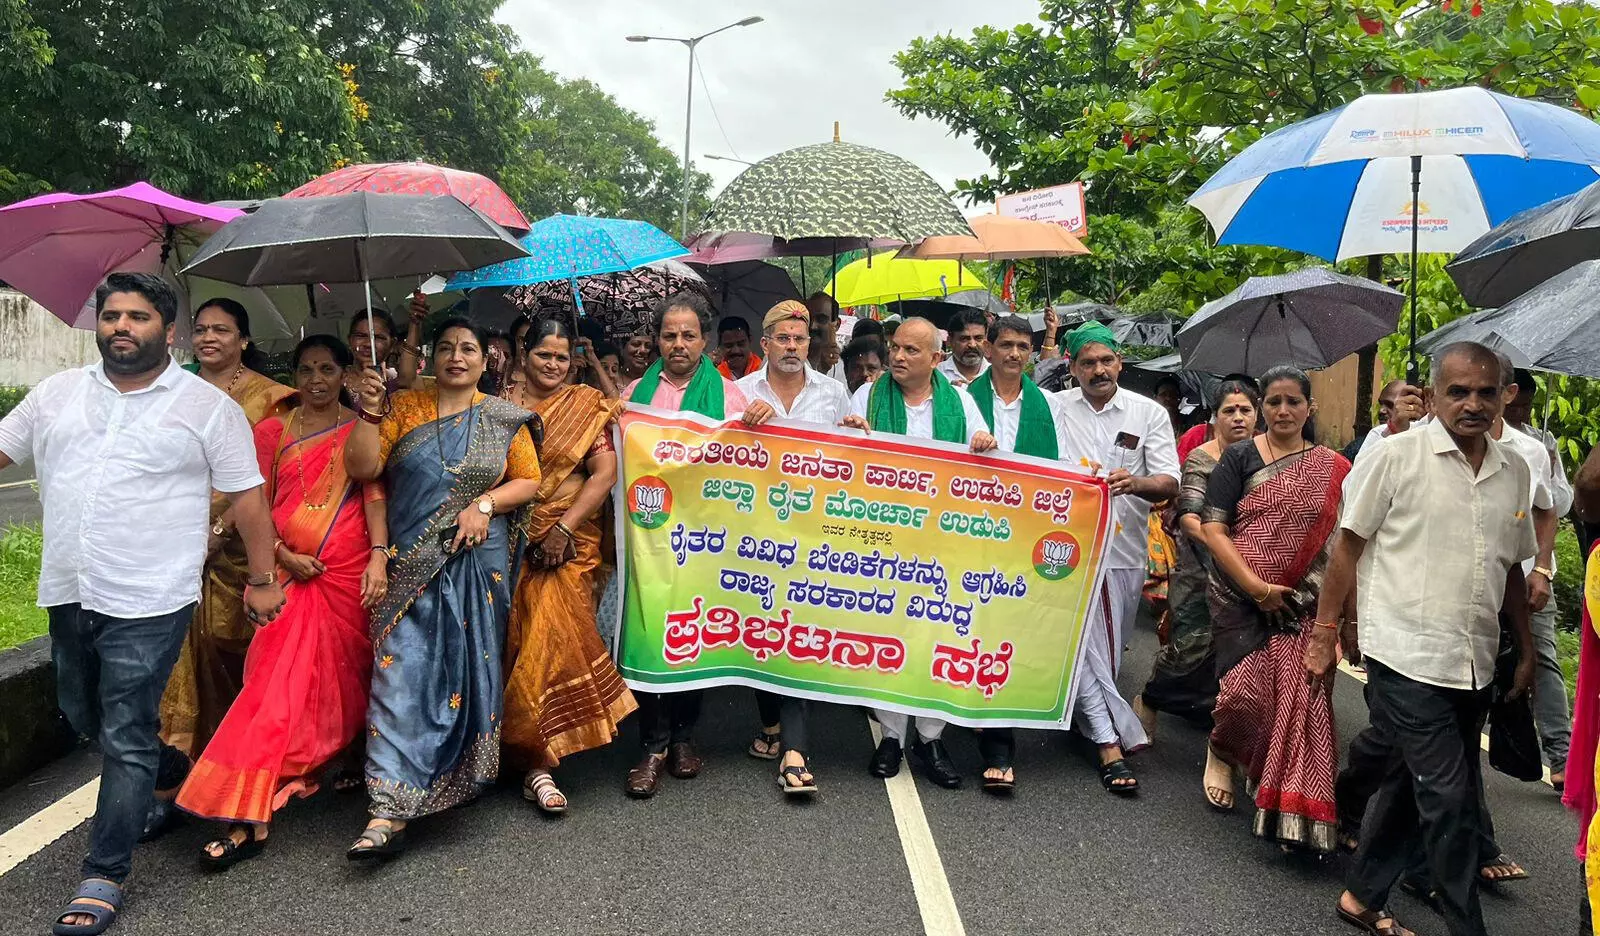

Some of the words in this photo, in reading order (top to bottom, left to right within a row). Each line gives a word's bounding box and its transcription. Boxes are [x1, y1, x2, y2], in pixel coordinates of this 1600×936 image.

[654, 440, 769, 470] ಭಾರತೀಯ
[781, 451, 853, 481] ಜನತಾ
[865, 463, 937, 496] ಪಾರ್ಟಿ,
[950, 475, 1023, 507] ಉಡುಪಿ
[1032, 487, 1072, 524] ಜಿಲ್ಲೆ
[702, 479, 755, 513] ಜಿಲ್ಲಾ
[767, 480, 813, 520] ರೈತ
[824, 489, 928, 529] ಮೋರ್ಚಾ
[940, 511, 1013, 542] ಉಡುಪಿ
[670, 523, 727, 566] ರೈತರ
[736, 535, 798, 569] ವಿವಿಧ
[808, 543, 948, 597] ಬೇಡಿಕೆಗಳನ್ನು
[961, 566, 1027, 603] ಆಗ್ರಹಿಸಿ
[822, 524, 845, 536] ಇವರ
[849, 526, 893, 546] ನೇತೃತ್ವದಲ್ಲಿ
[720, 568, 775, 611] ರಾಜ್ಯ
[787, 577, 896, 616] ಸರಕಾರದ
[906, 595, 973, 637] ವಿರುದ್ಧ
[663, 597, 905, 673] ಪ್ರತಿಭಟನಾ
[931, 639, 1014, 697] ಸಭೆ
